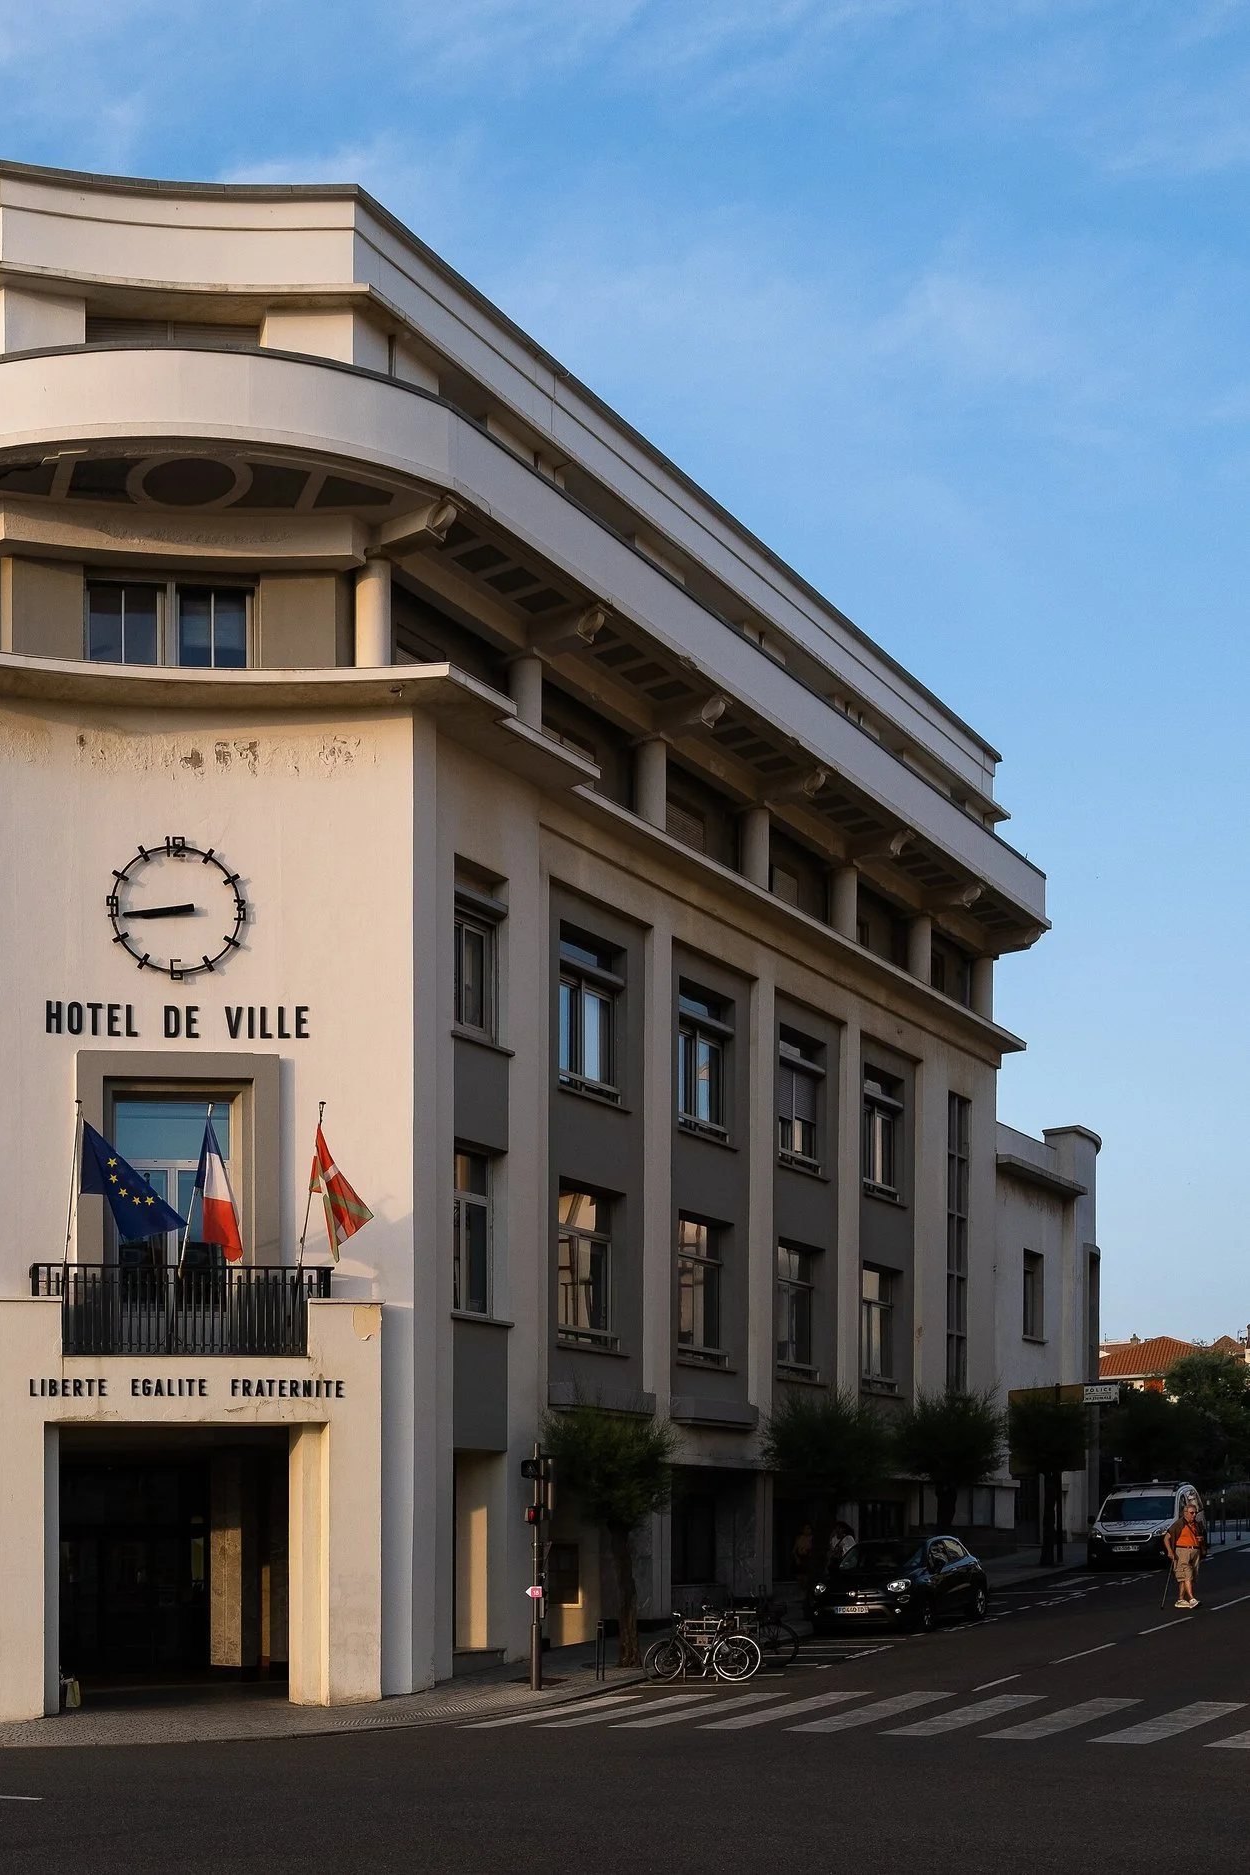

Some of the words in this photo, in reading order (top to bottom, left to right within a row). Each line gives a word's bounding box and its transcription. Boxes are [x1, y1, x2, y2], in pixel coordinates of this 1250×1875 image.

[165, 836, 186, 857] 12
[106, 896, 119, 917] 9
[234, 899, 246, 921] 3
[170, 959, 184, 980] 6
[46, 1001, 138, 1037] HOTEL
[164, 1006, 200, 1038] DE
[225, 1006, 310, 1039] VILLE
[29, 1378, 107, 1397] LIBERTE
[131, 1378, 207, 1397] EGALITE
[231, 1379, 345, 1398] FRATERNITE
